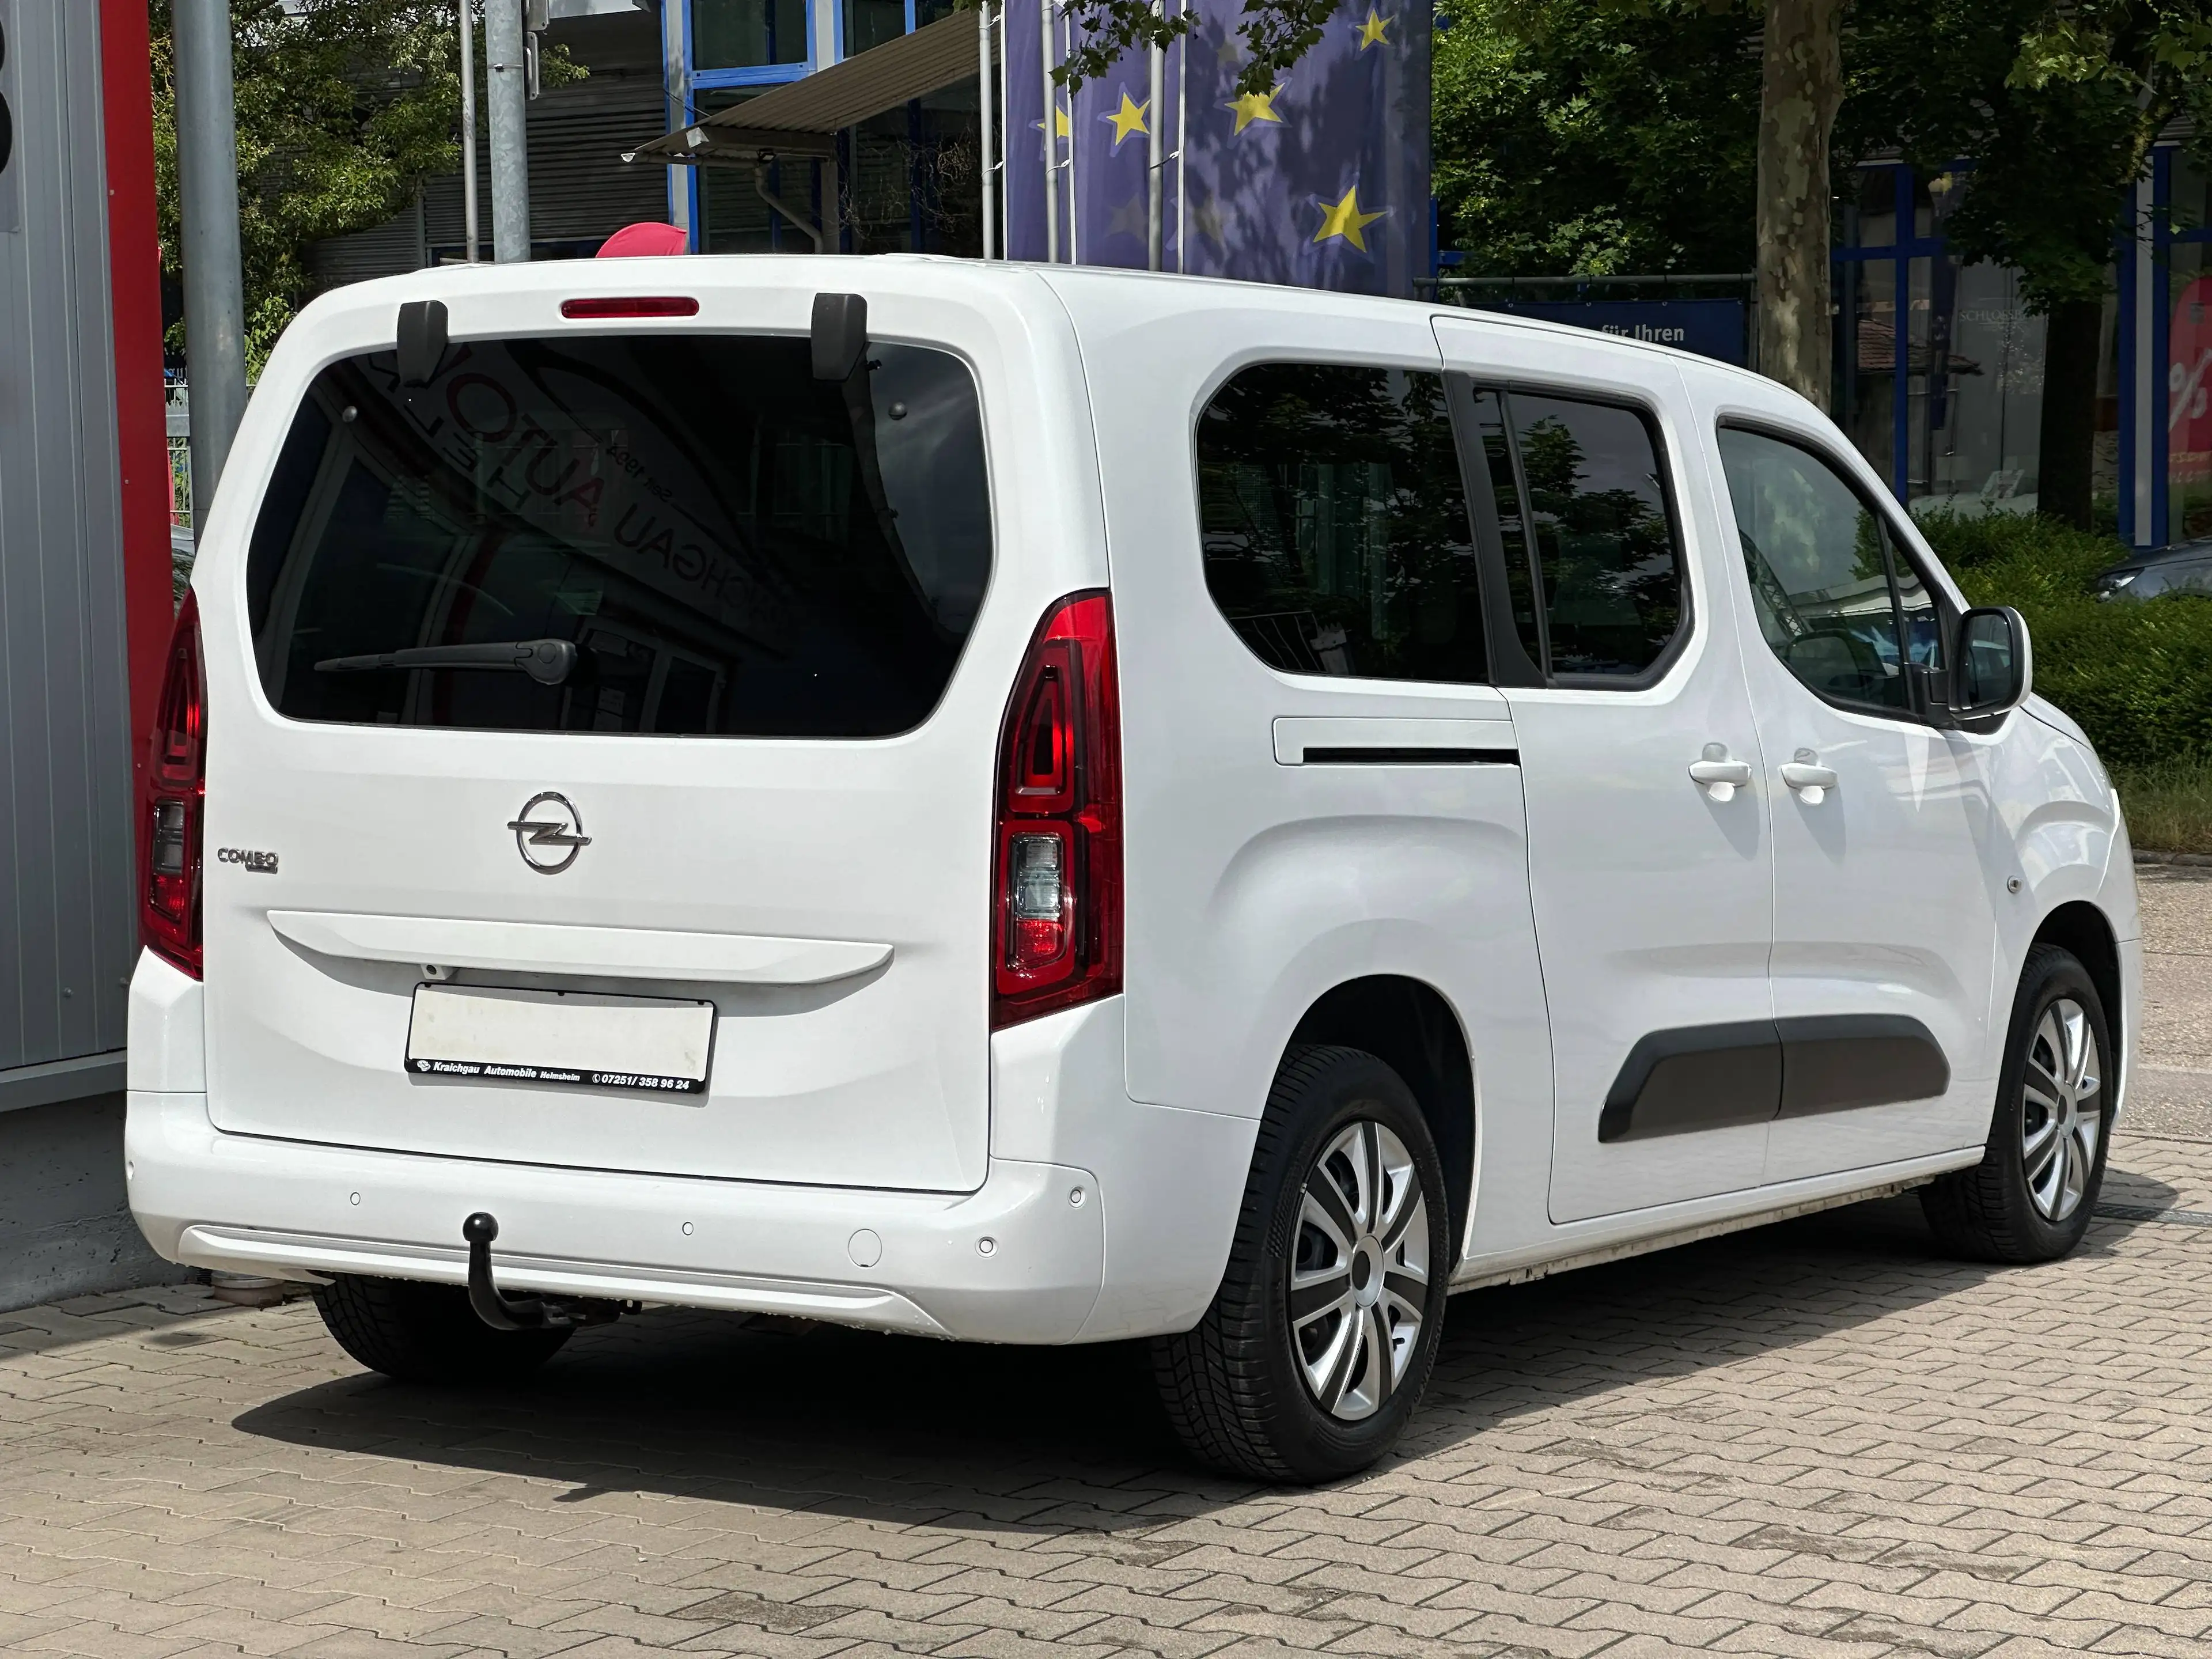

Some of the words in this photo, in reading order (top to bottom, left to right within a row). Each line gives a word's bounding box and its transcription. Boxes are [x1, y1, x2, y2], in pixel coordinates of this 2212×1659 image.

[1635, 324, 1684, 342] Ihren
[217, 847, 279, 865] COMBO
[433, 1062, 480, 1075] Kraichgau
[484, 1065, 537, 1078] Automobile
[601, 1075, 638, 1086] 07251/
[639, 1077, 658, 1088] 358
[660, 1078, 674, 1089] 96
[675, 1080, 690, 1090] 24
